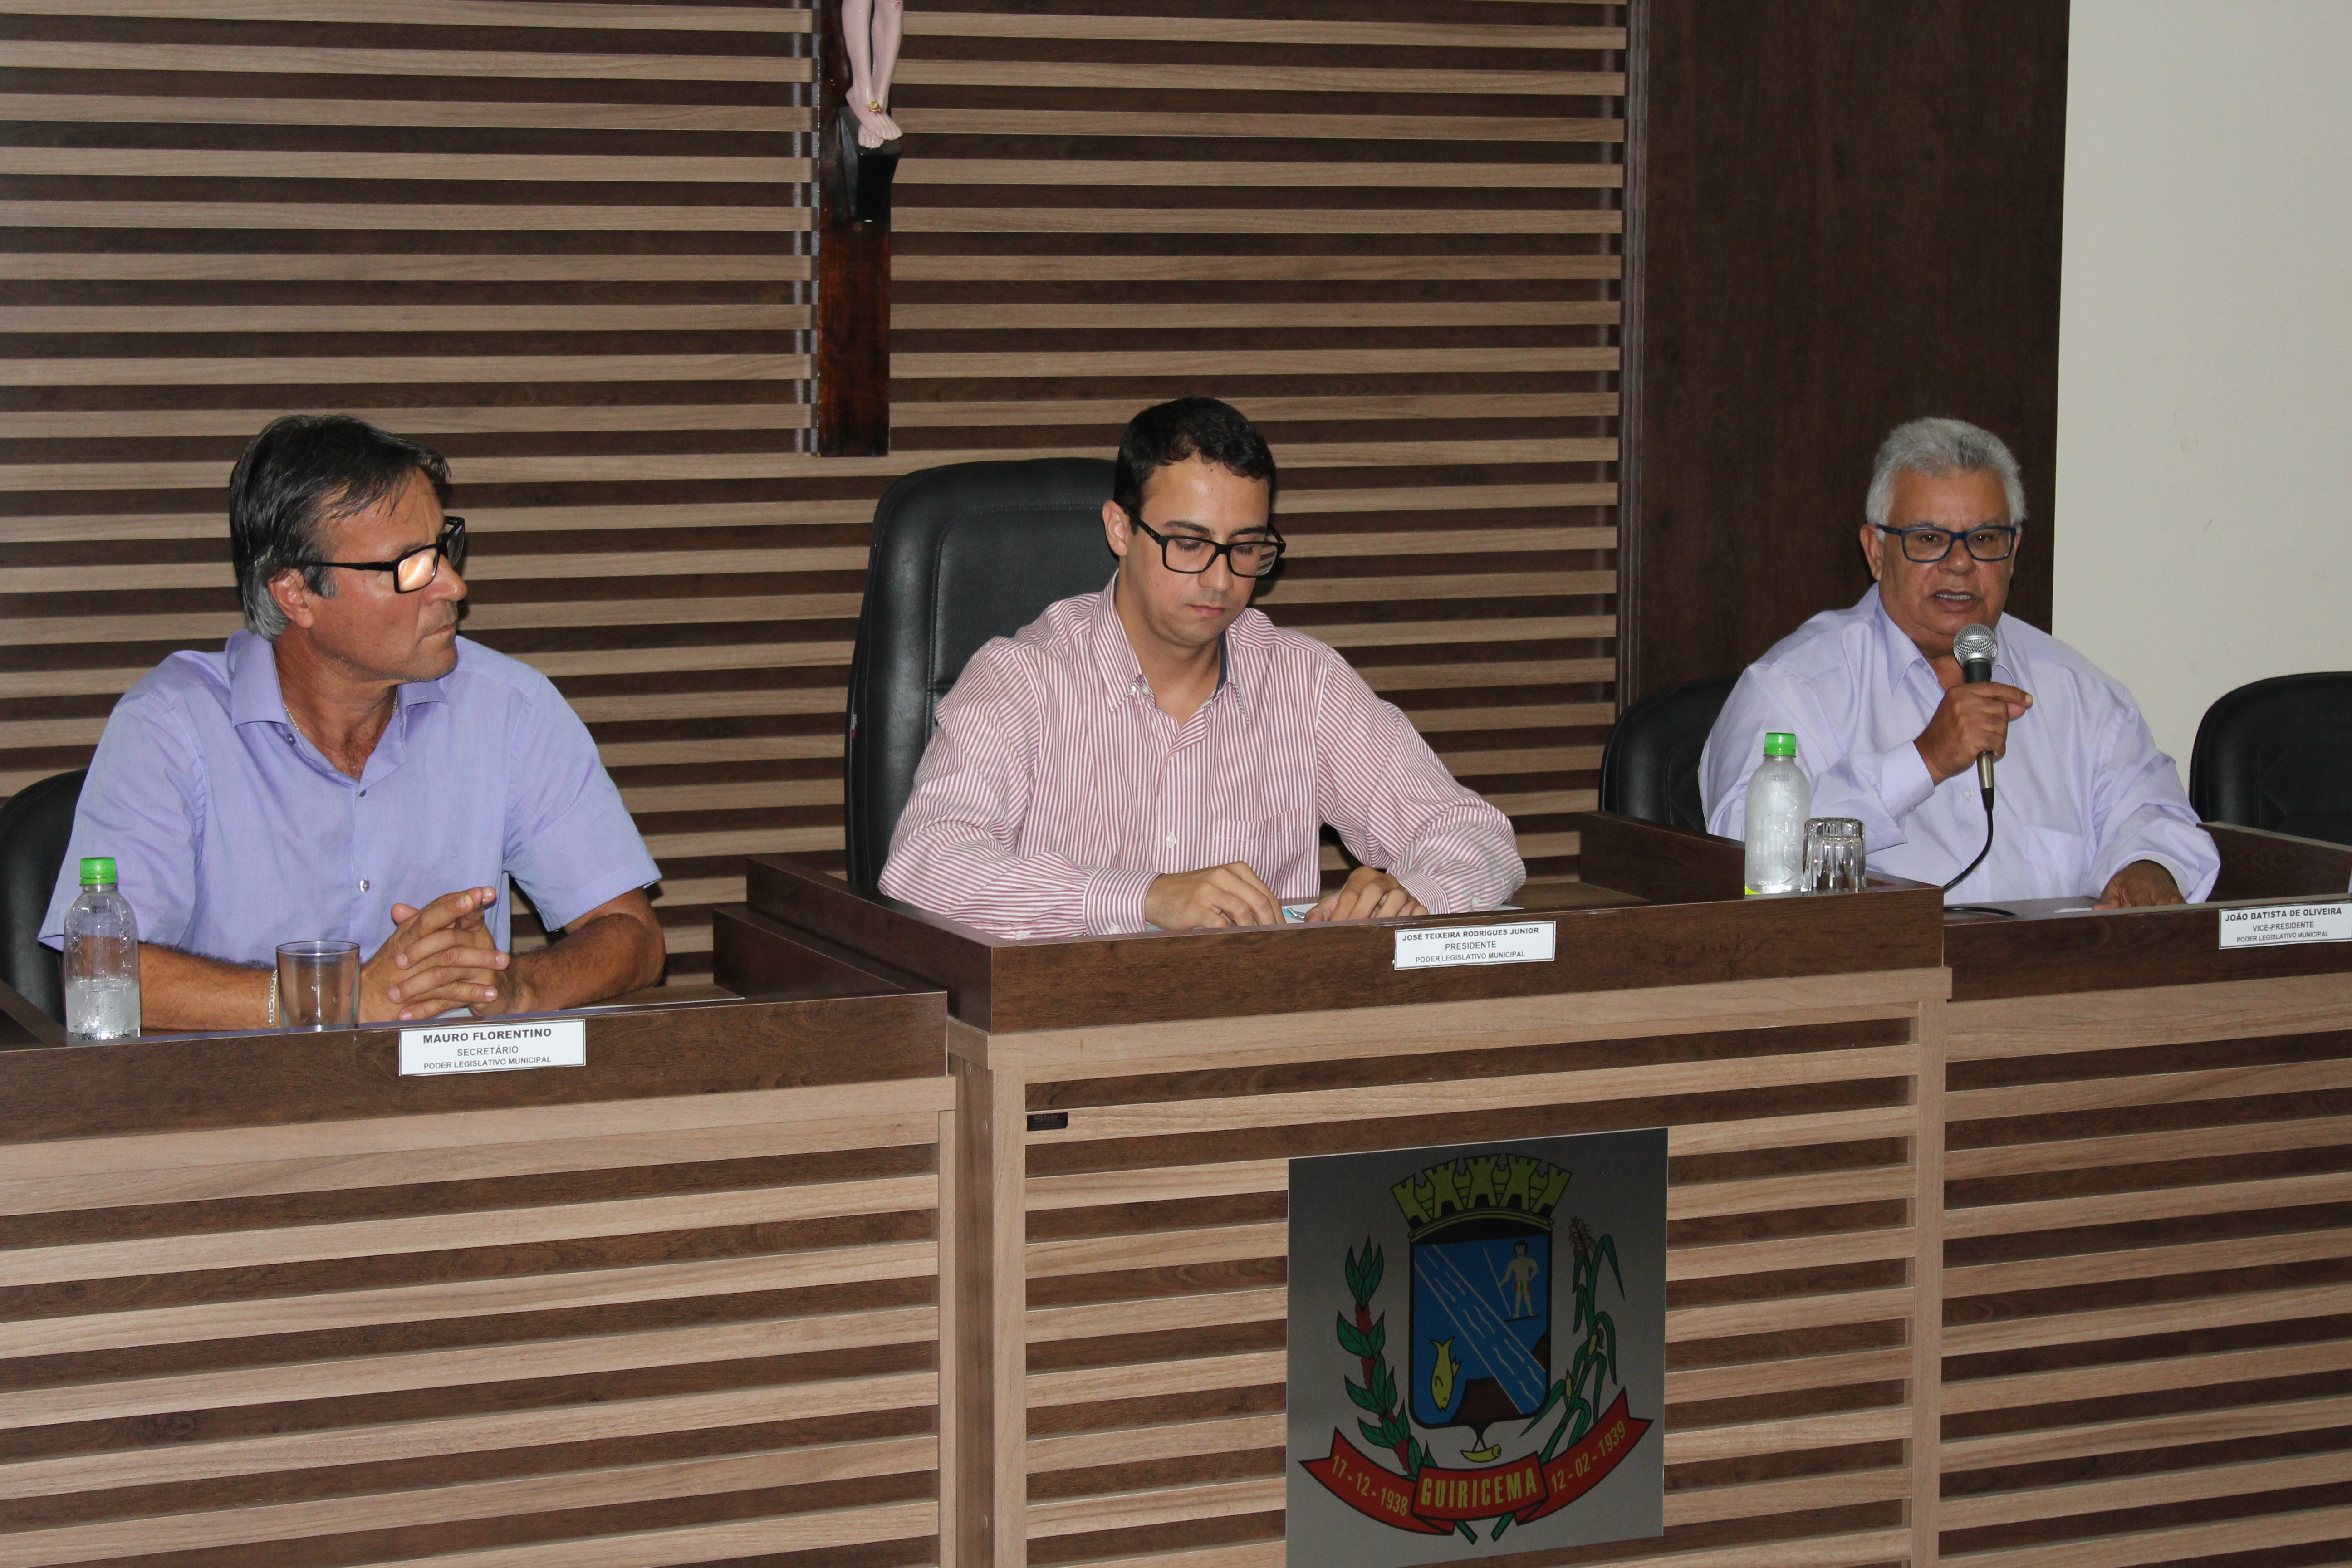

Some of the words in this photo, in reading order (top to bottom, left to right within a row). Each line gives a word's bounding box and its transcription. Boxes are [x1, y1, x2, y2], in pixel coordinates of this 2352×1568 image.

[2225, 913, 2248, 921] JOÃO
[2251, 911, 2287, 919] BATISTA
[2253, 921, 2313, 931] VICE-PRESIDENTE
[1446, 941, 1496, 950] PRESIDENTE
[423, 1033, 468, 1043] MAURO
[473, 1029, 551, 1040] FLORENTINO
[457, 1045, 518, 1056] SECRETÁRIO
[454, 1059, 506, 1068] LEGISLATIVO
[1421, 1467, 1537, 1508] GUIRICEMA
